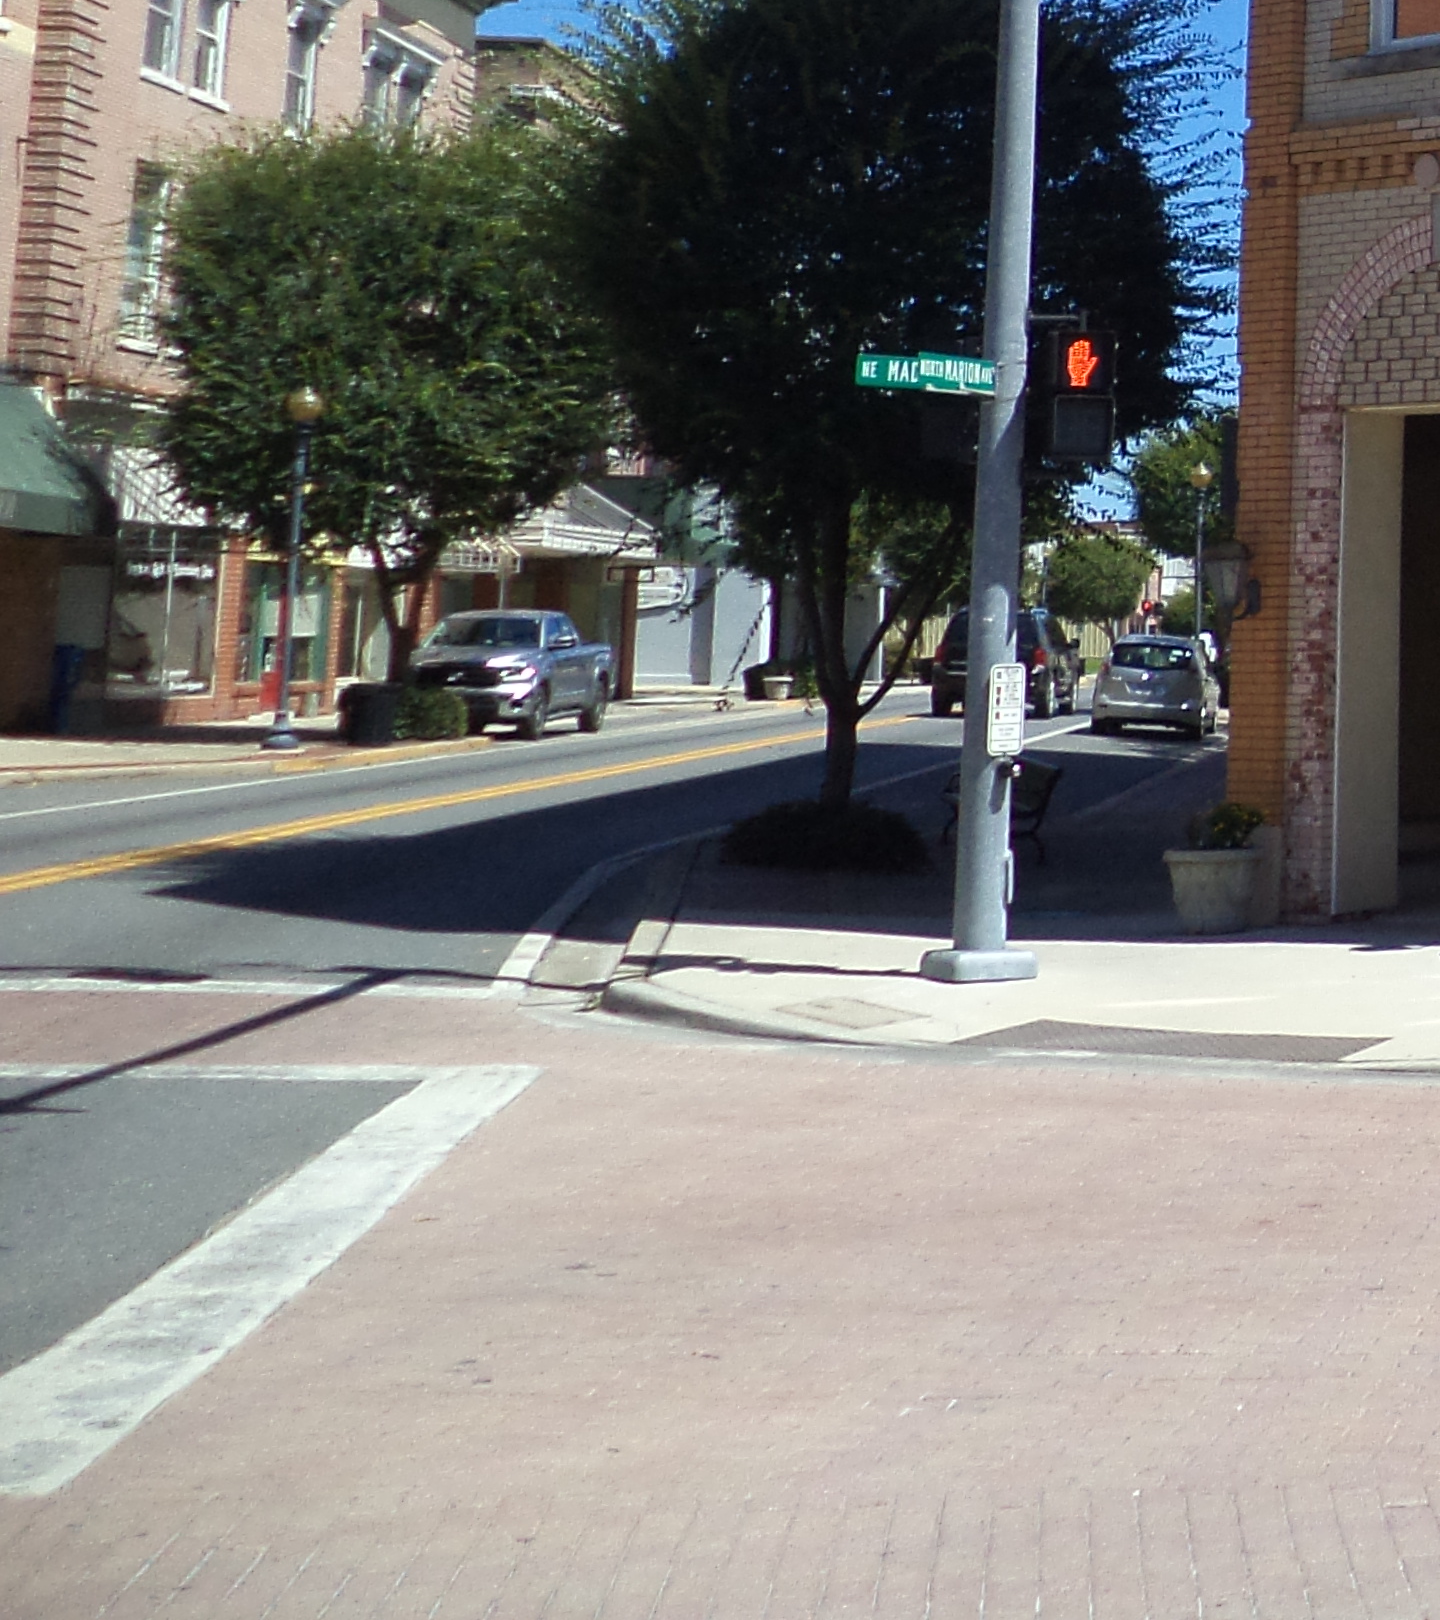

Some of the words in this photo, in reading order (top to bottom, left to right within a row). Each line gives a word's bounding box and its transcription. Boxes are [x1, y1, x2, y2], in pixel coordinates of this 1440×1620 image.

[862, 361, 878, 378] NE
[945, 359, 981, 384] MARION
[981, 367, 995, 384] AVE
